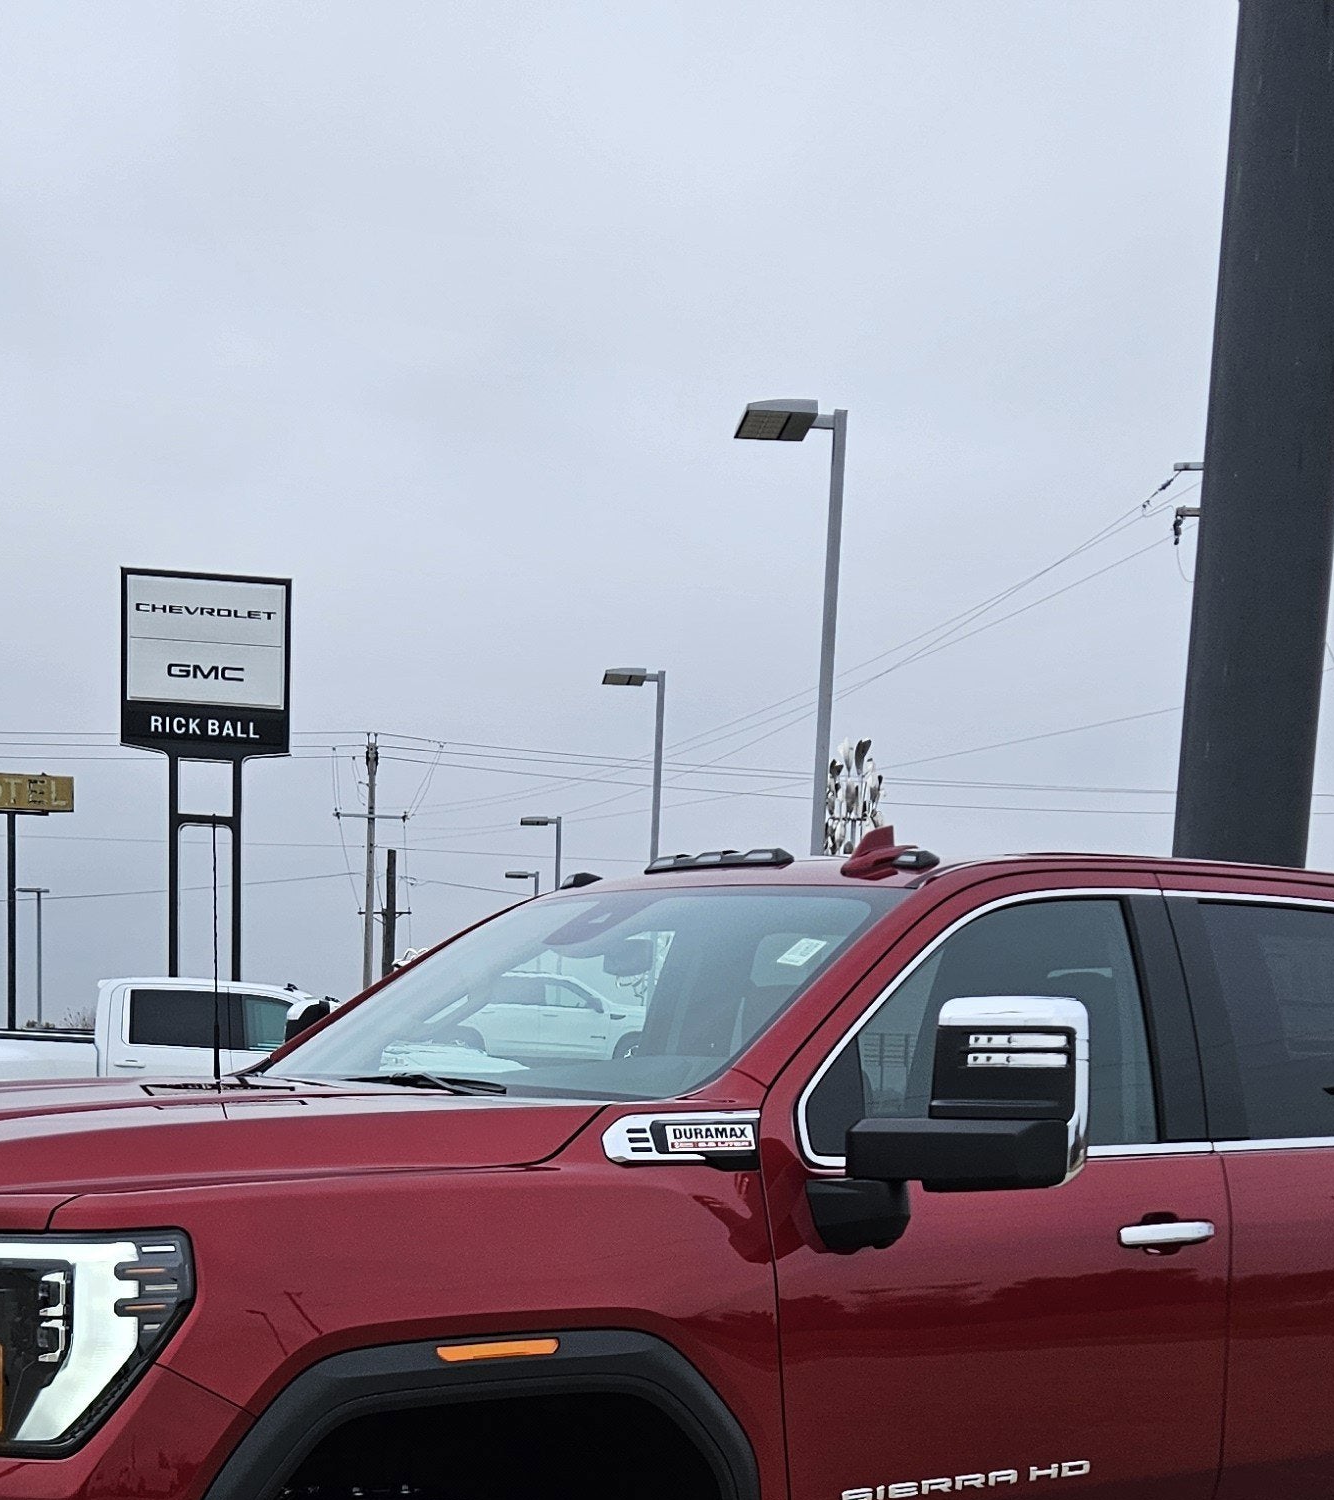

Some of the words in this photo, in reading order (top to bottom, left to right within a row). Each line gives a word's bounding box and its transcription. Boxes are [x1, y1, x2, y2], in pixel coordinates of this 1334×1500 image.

[134, 602, 277, 621] CHEVROLET
[166, 662, 245, 682] GMC
[150, 715, 201, 735] RICK
[208, 719, 260, 739] BALL
[672, 1127, 748, 1139] DURAMAX
[1028, 1460, 1091, 1482] HD
